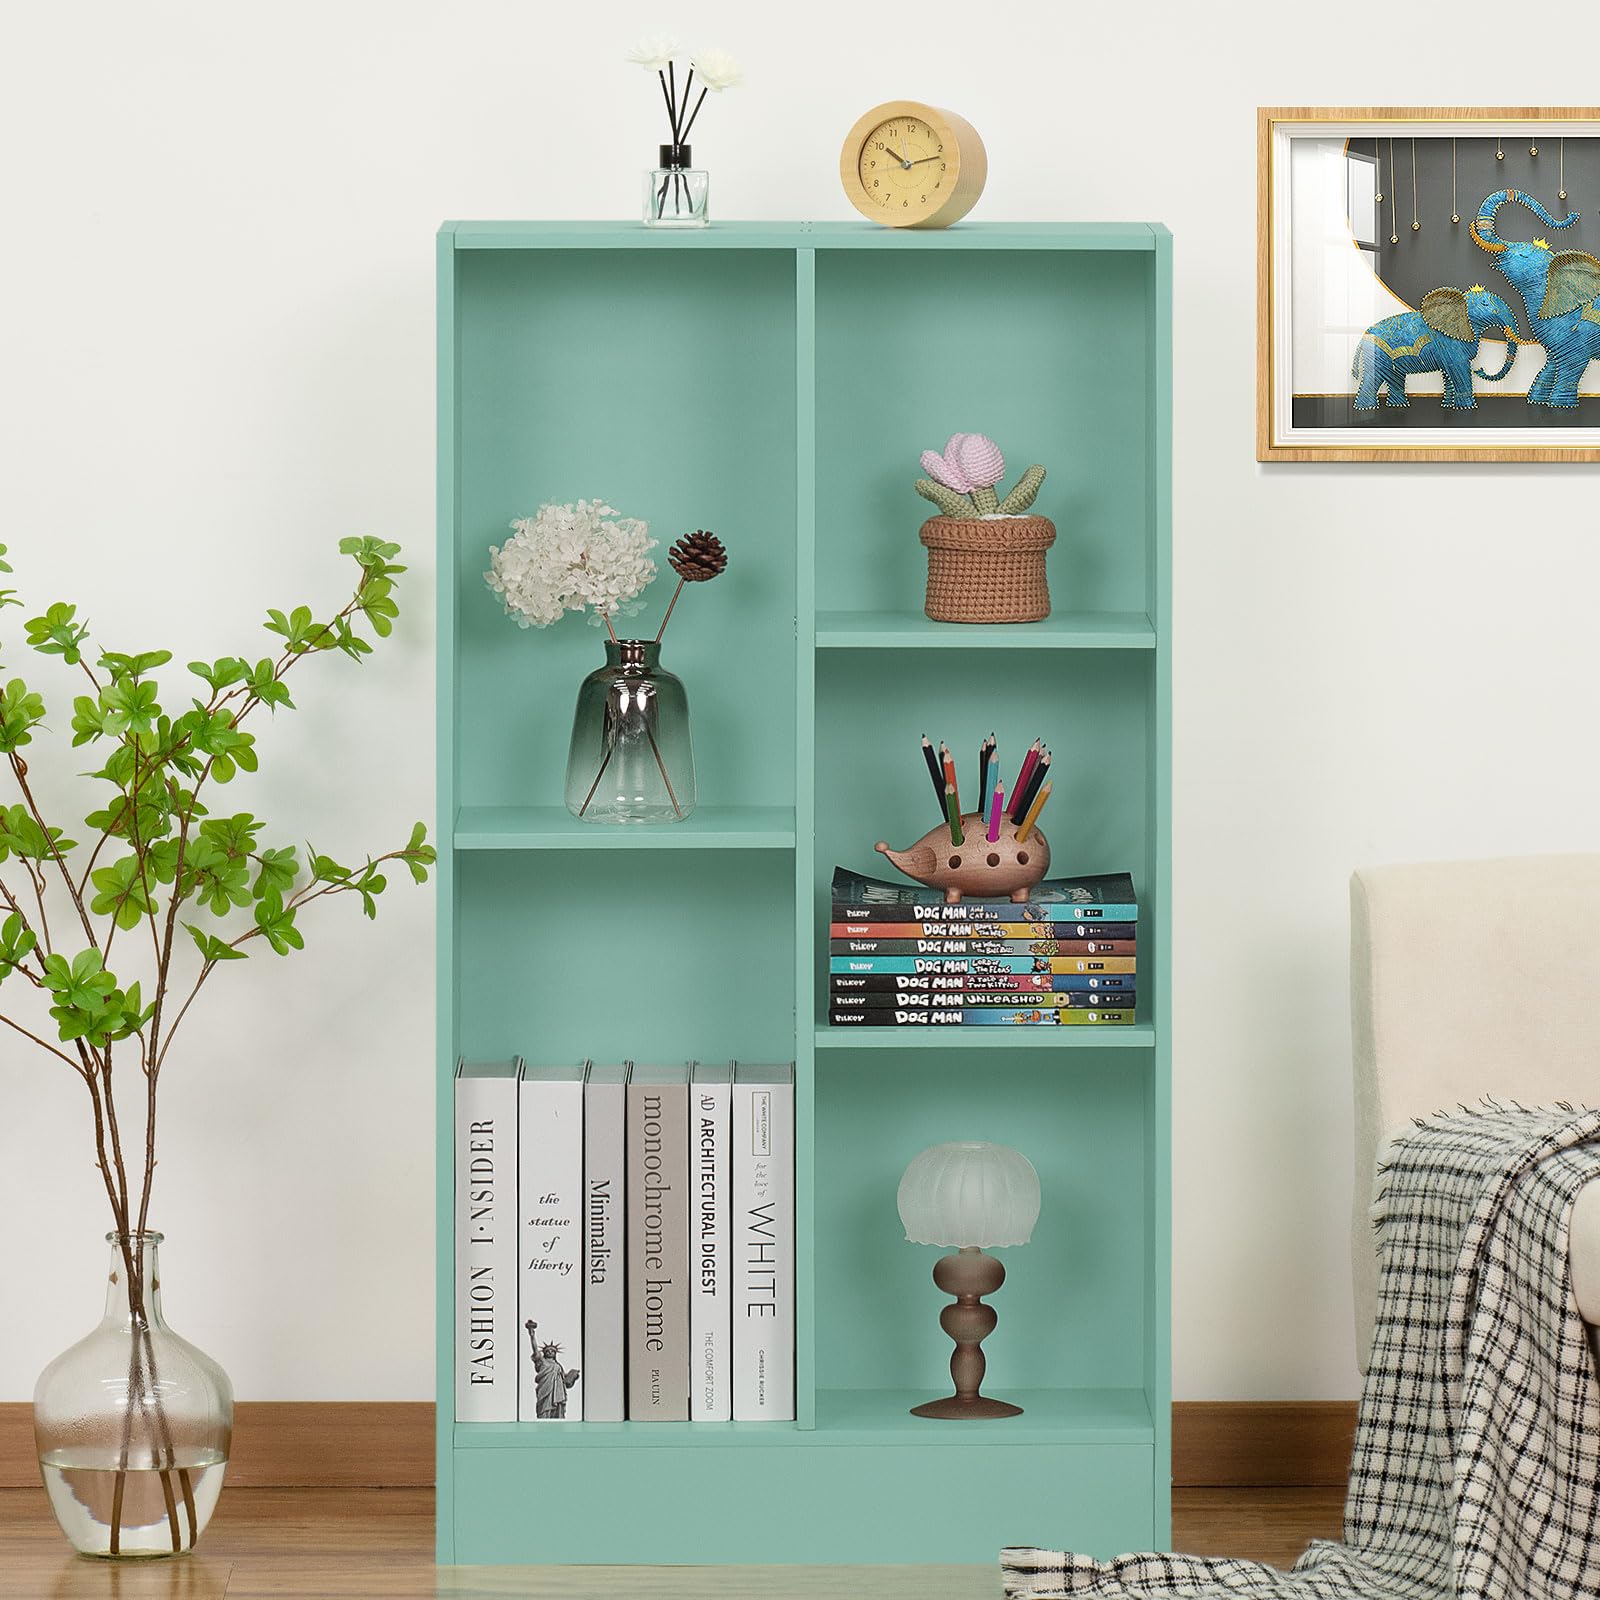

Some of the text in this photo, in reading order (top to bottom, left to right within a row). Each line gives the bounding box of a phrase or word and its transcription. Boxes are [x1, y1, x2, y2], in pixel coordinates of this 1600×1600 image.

[907, 125, 916, 133] 12
[875, 143, 885, 151] 10
[937, 144, 943, 152] 2
[940, 163, 946, 171] 3
[873, 180, 879, 188] 8
[885, 194, 891, 202] 7
[902, 200, 908, 208] 6
[921, 195, 926, 203] 5
[913, 905, 967, 919] DOG MAN
[922, 923, 971, 936] DOG MAN
[917, 940, 967, 953] DOG MAN
[914, 959, 968, 973] DOG MAN
[896, 976, 963, 989] DOG MAN
[896, 993, 964, 1006] DOG MAN
[895, 1010, 963, 1024] DOG MAN
[538, 1193, 560, 1205] the
[701, 1094, 716, 1296] AD ARCHITECTURAL DIGEST
[528, 1217, 570, 1227] statue
[643, 1096, 672, 1351] monochrome home
[590, 1180, 611, 1285] Minimalista
[542, 1235, 560, 1253] of
[748, 1202, 775, 1317] WHITE
[528, 1258, 573, 1276] liberty
[470, 1266, 494, 1385] FASHION
[705, 1332, 714, 1410] THE COMFORT ZOOM
[651, 1369, 660, 1405] PIA ULIN
